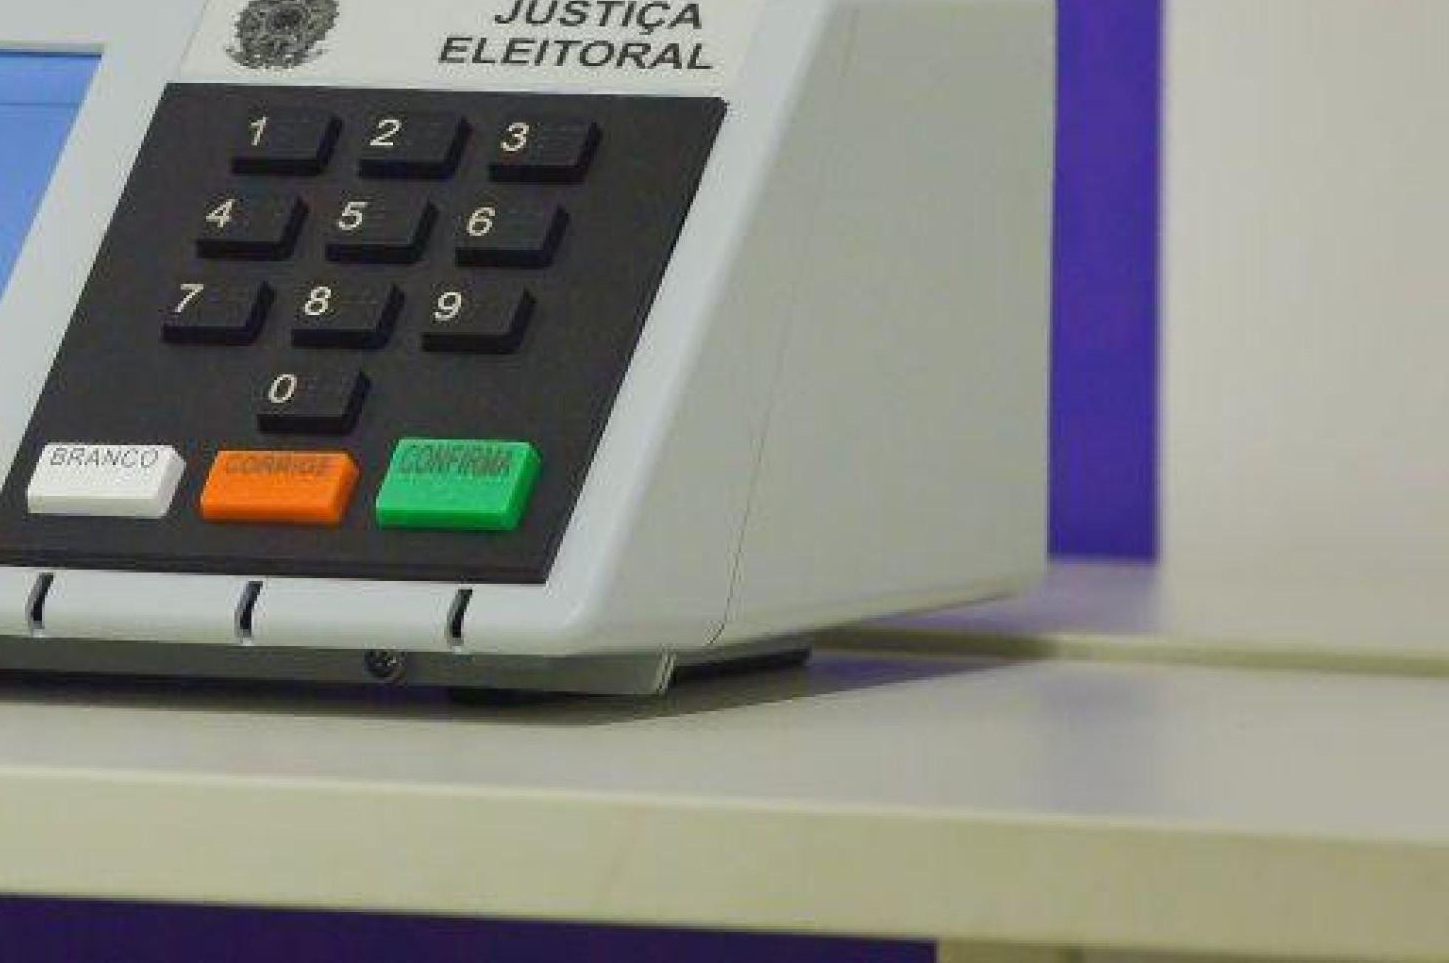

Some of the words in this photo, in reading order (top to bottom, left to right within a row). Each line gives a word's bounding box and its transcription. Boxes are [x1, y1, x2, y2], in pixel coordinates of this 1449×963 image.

[437, 34, 716, 71] ELEITORAL
[249, 115, 268, 147] 1
[368, 117, 403, 148] 2
[499, 121, 531, 153] 3
[204, 197, 236, 229] 4
[337, 200, 370, 232] 5
[465, 205, 498, 238] 6
[173, 282, 206, 314] 7
[301, 285, 333, 317] 8
[432, 290, 464, 323] 9
[267, 372, 299, 405] 0
[49, 445, 161, 470] BRANCO
[399, 445, 514, 476] CONFIRMA
